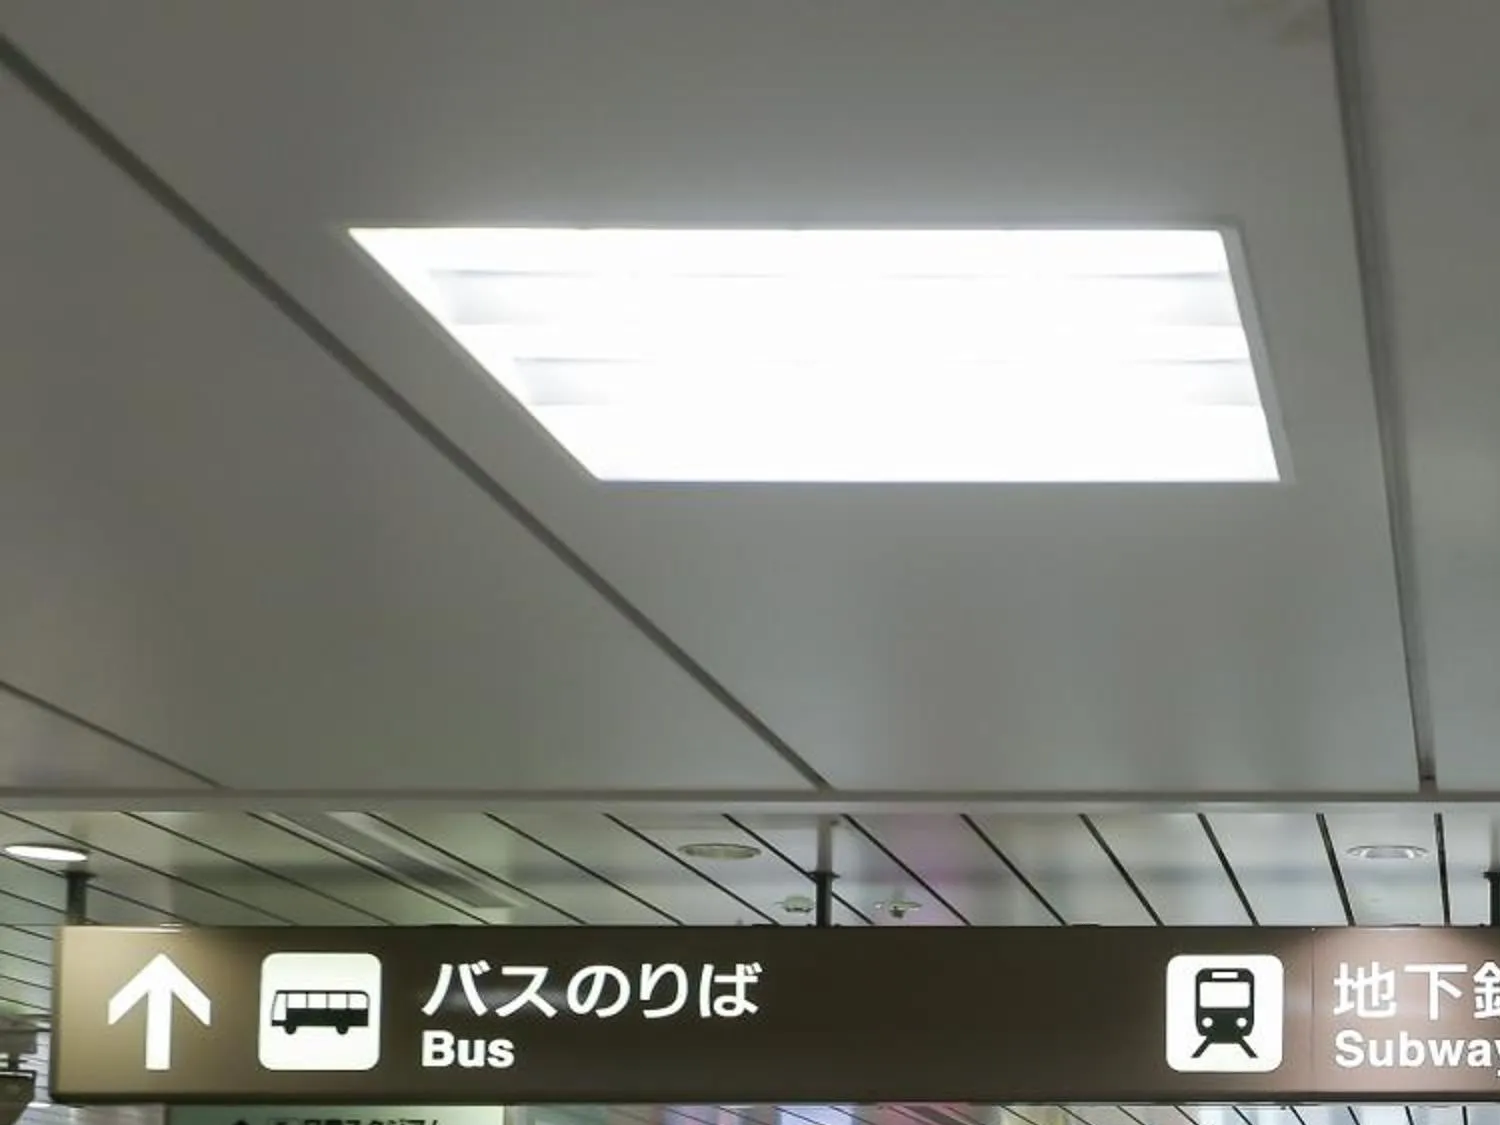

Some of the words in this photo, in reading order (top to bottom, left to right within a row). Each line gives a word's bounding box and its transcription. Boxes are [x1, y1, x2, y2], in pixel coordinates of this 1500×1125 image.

[422, 960, 763, 1018] バスのりば
[422, 1030, 514, 1068] Bus
